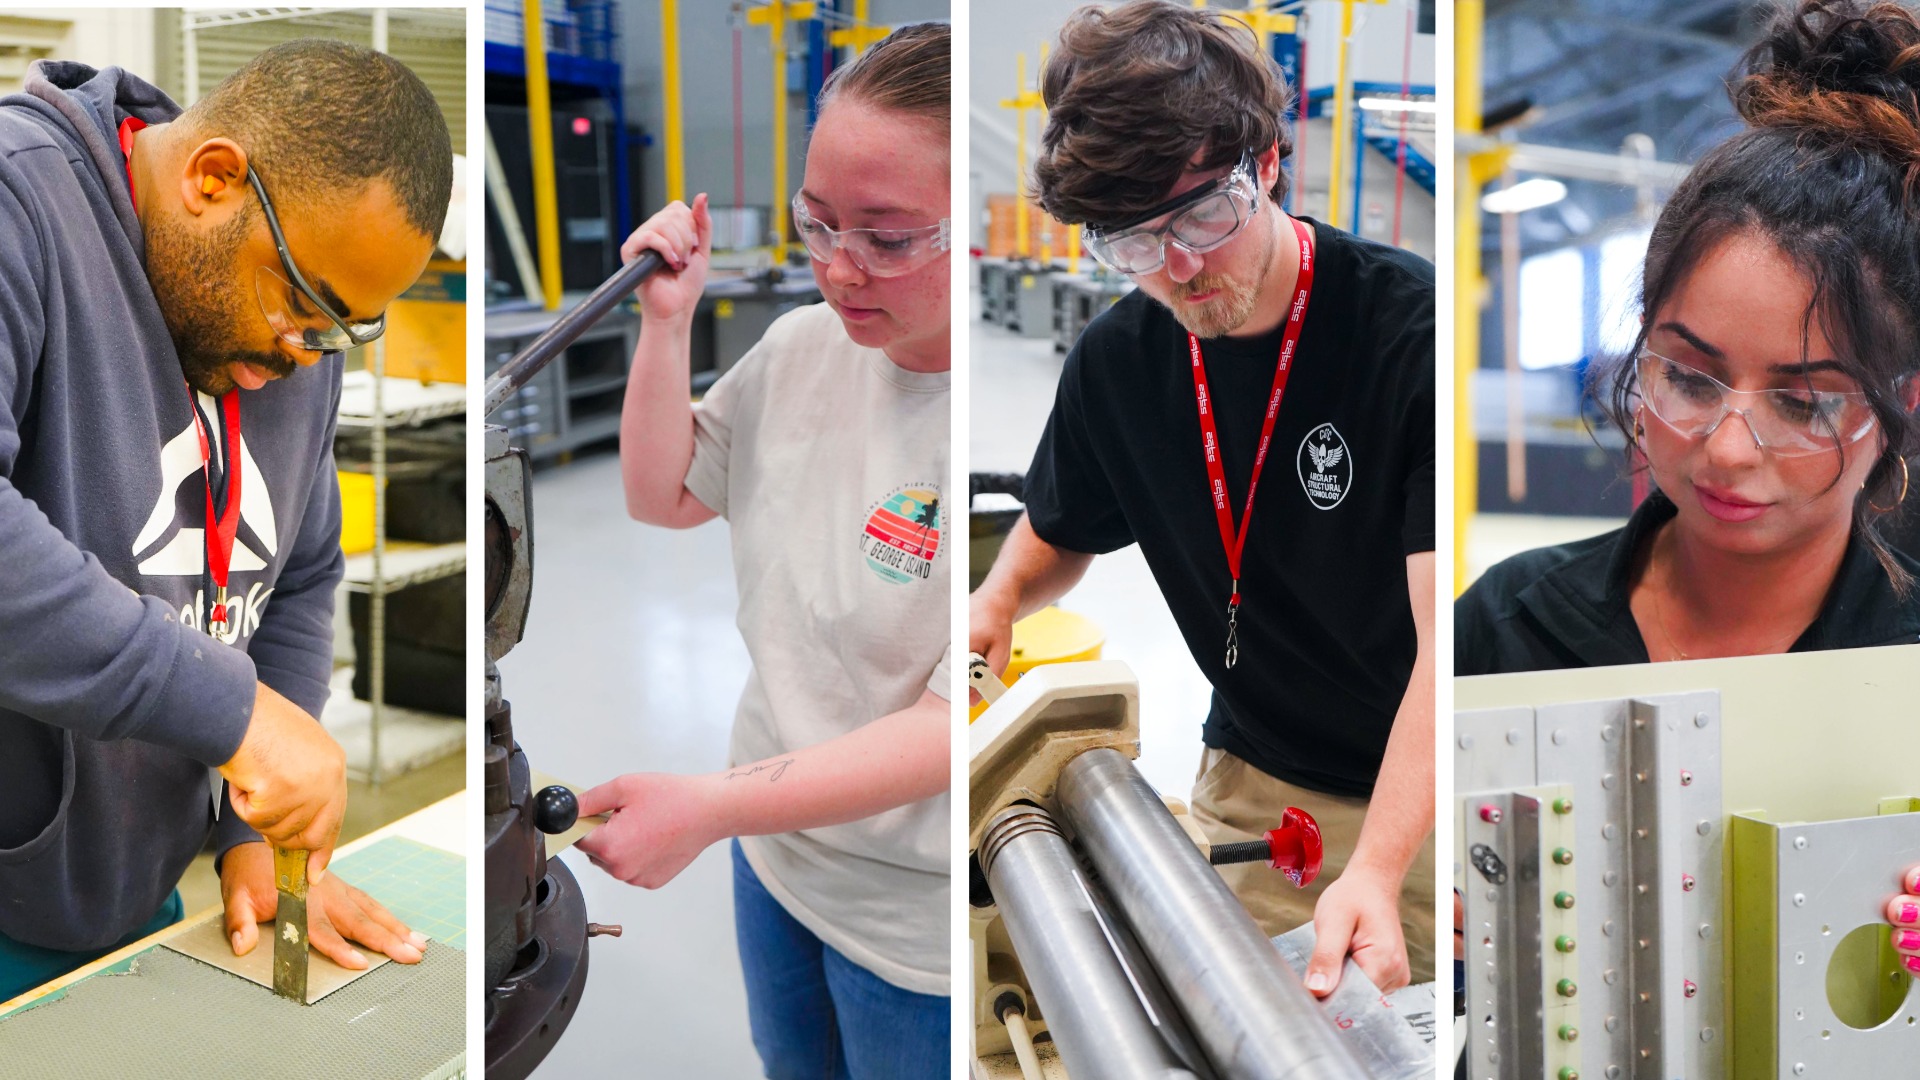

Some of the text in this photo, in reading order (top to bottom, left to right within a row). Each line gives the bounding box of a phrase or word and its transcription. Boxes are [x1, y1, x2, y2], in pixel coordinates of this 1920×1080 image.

[1309, 472, 1338, 484] AIRCRAFT
[1307, 479, 1342, 493] STRUCTURAL
[1309, 488, 1340, 501] TECHNOLOGY
[870, 541, 905, 569] GEORGE
[903, 555, 931, 580] ISLAND
